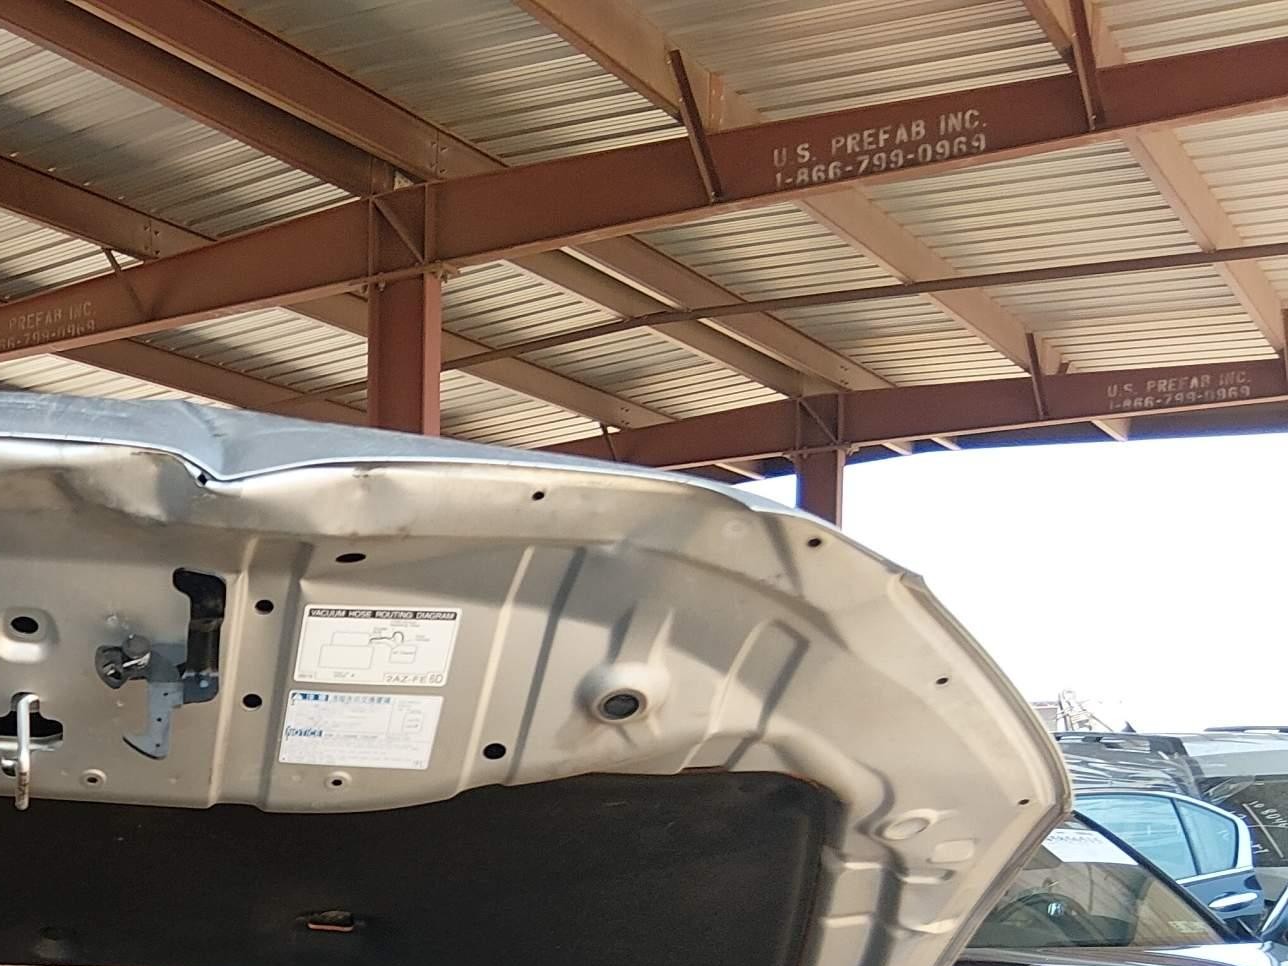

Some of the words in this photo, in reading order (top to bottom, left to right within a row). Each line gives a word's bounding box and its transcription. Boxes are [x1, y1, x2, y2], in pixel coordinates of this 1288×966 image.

[830, 118, 927, 155] PREFAB
[939, 108, 988, 136] INC.
[1146, 373, 1211, 393] PREFAB
[310, 609, 346, 617] VACUUM
[348, 610, 372, 618] HOSE
[375, 611, 414, 619] ROUTING
[415, 611, 456, 620] DIAGRAM
